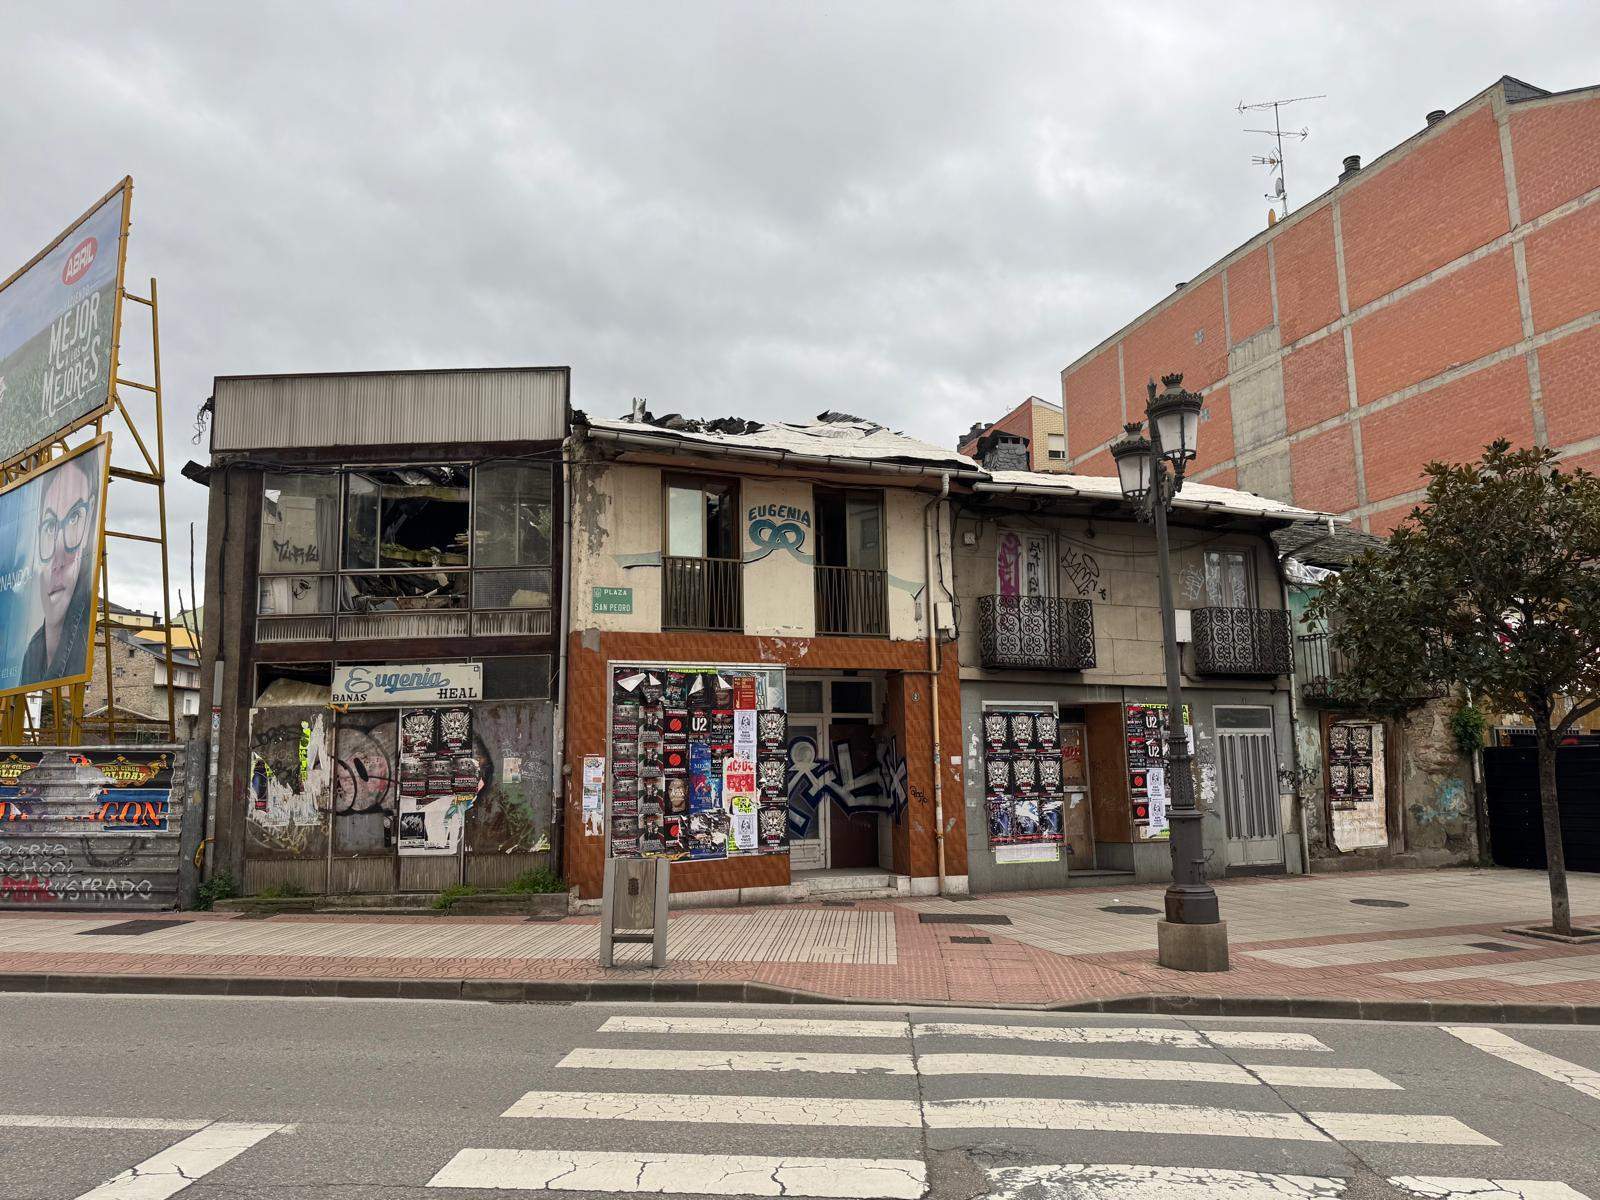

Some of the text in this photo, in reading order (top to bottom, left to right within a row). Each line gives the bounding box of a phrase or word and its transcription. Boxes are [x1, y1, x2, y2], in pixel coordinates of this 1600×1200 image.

[65, 242, 94, 281] ABRIL
[49, 291, 101, 370] MEJOR
[41, 335, 101, 418] MEJORES
[749, 504, 810, 528] EUGENIA
[595, 603, 631, 612] SAN PEDRO
[344, 667, 450, 694] Eugenia
[692, 717, 707, 731] U2
[1145, 716, 1157, 728] U2
[1148, 747, 1160, 757] U2
